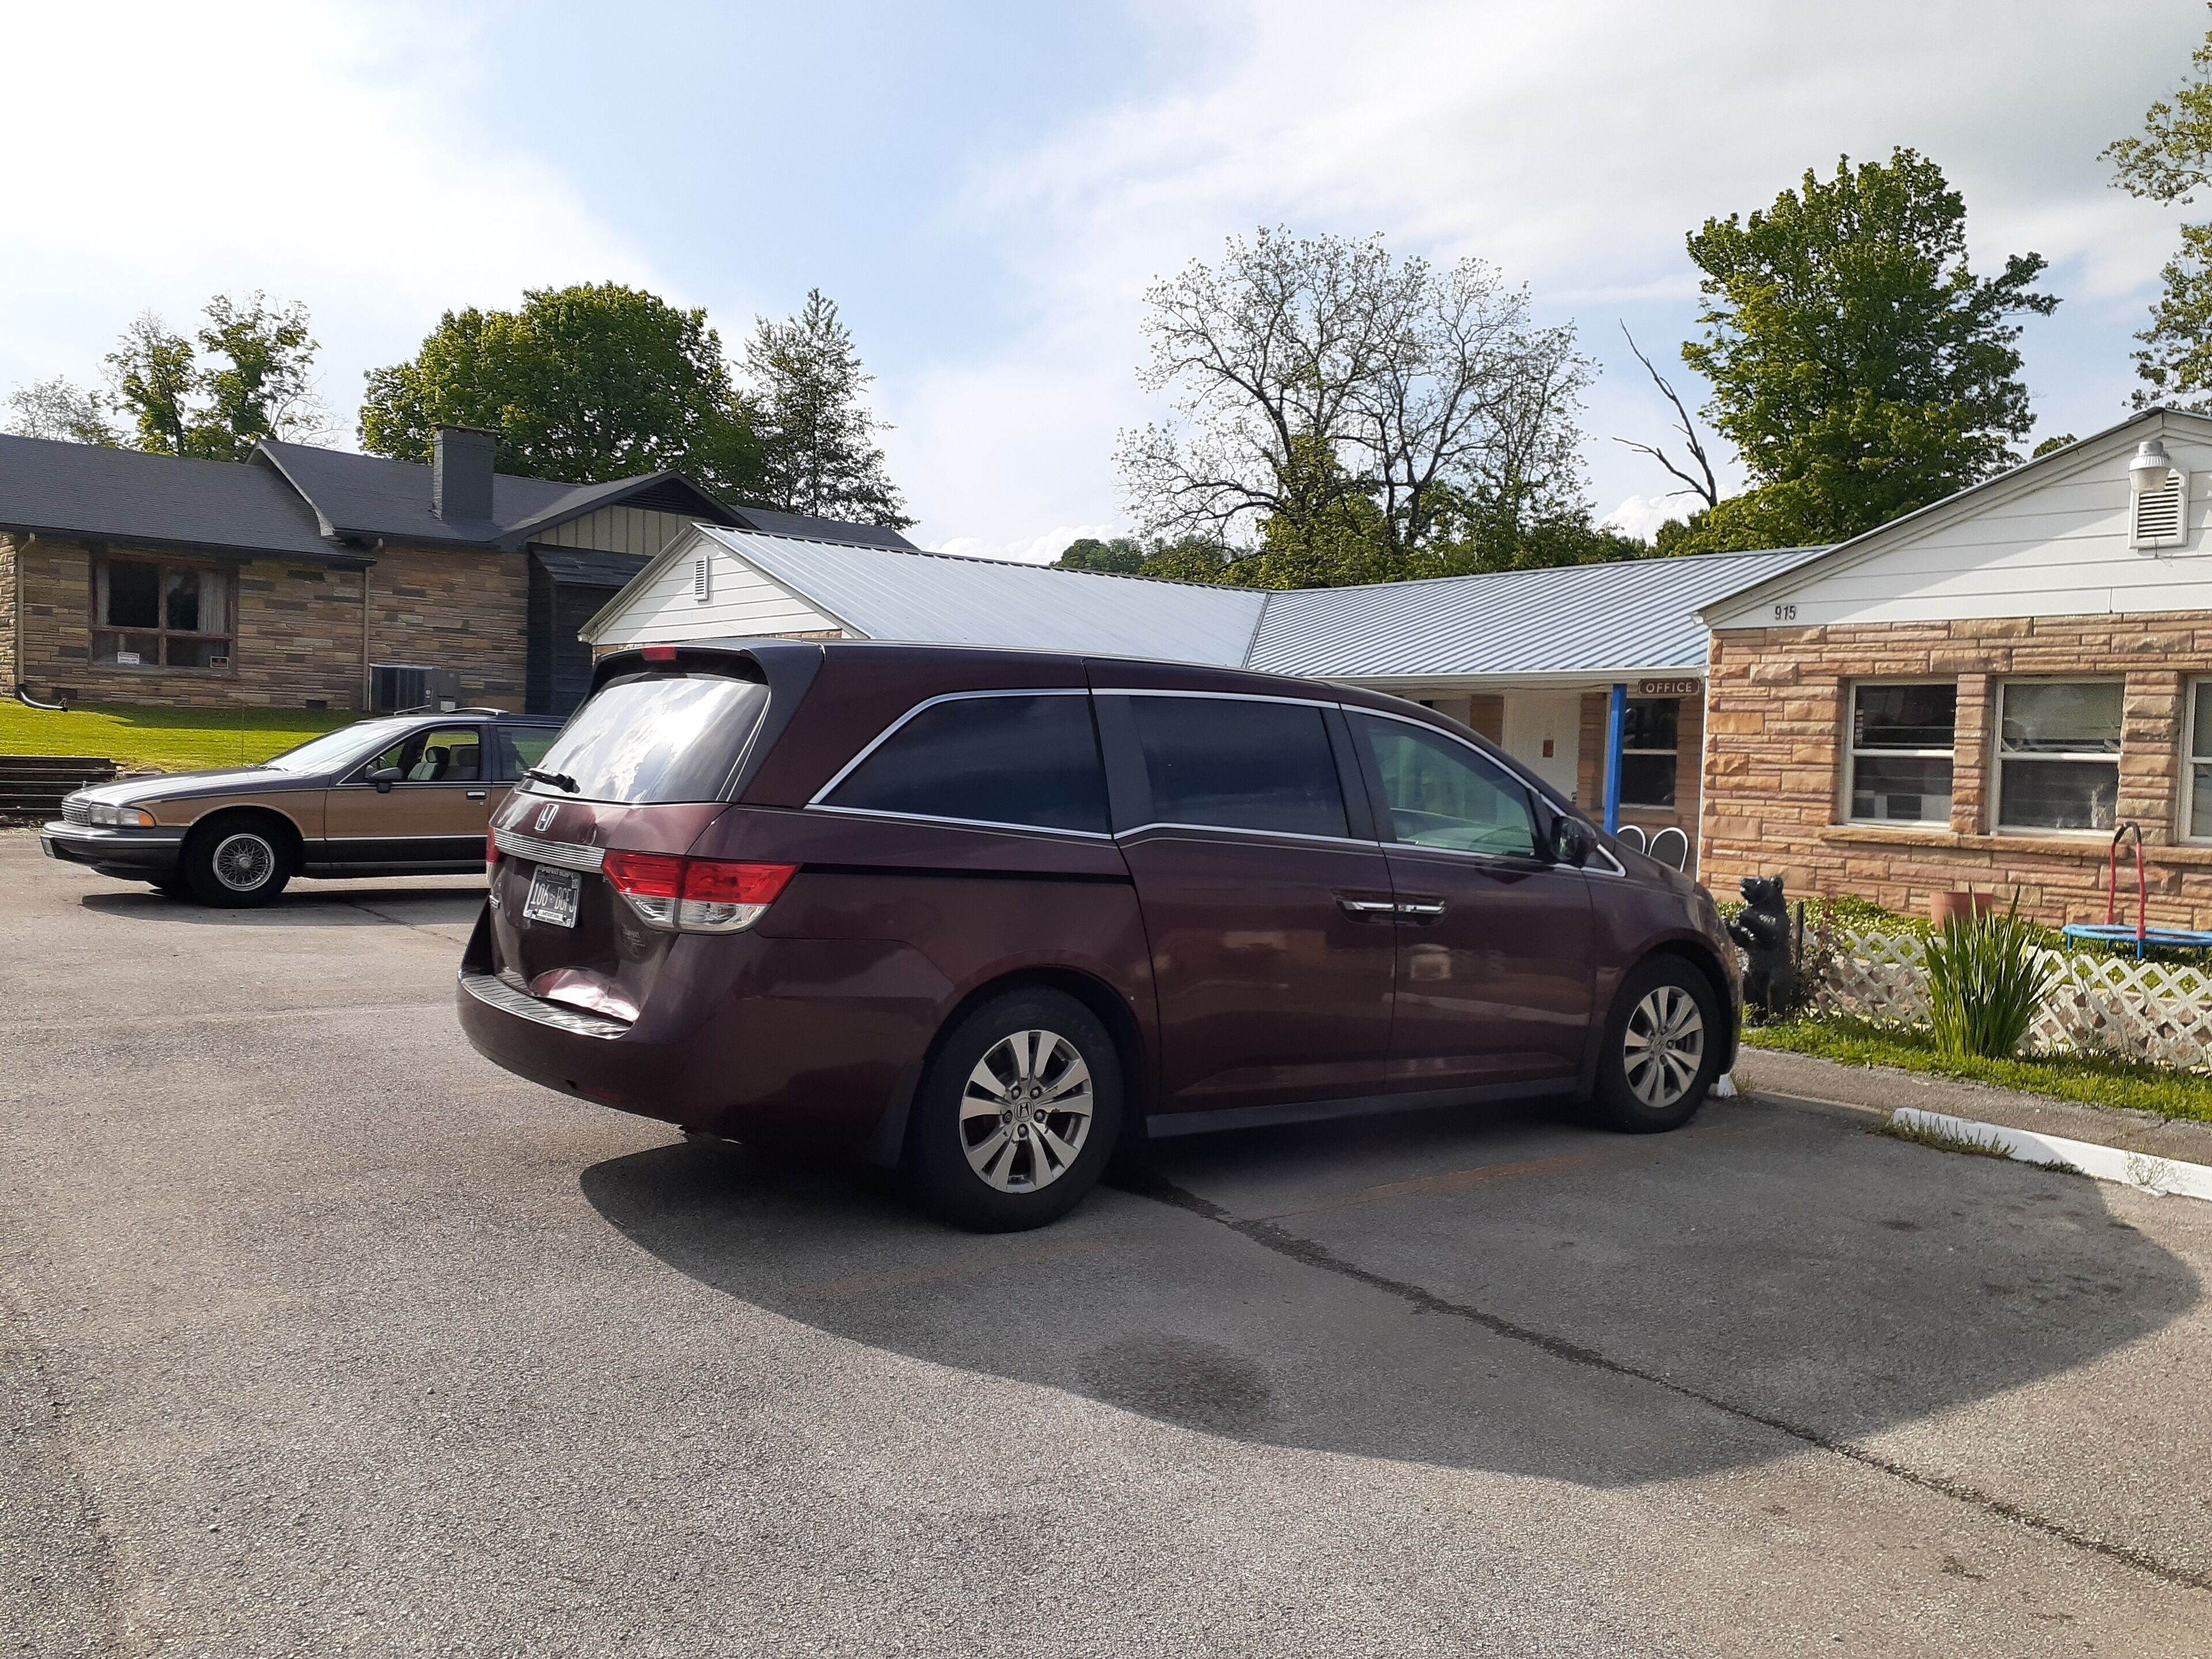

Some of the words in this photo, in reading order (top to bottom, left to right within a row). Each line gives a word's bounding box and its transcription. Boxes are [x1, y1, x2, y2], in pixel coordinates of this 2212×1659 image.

[1775, 605, 1796, 620] 915
[1646, 682, 1692, 693] OFFICE
[530, 882, 550, 907] 106
